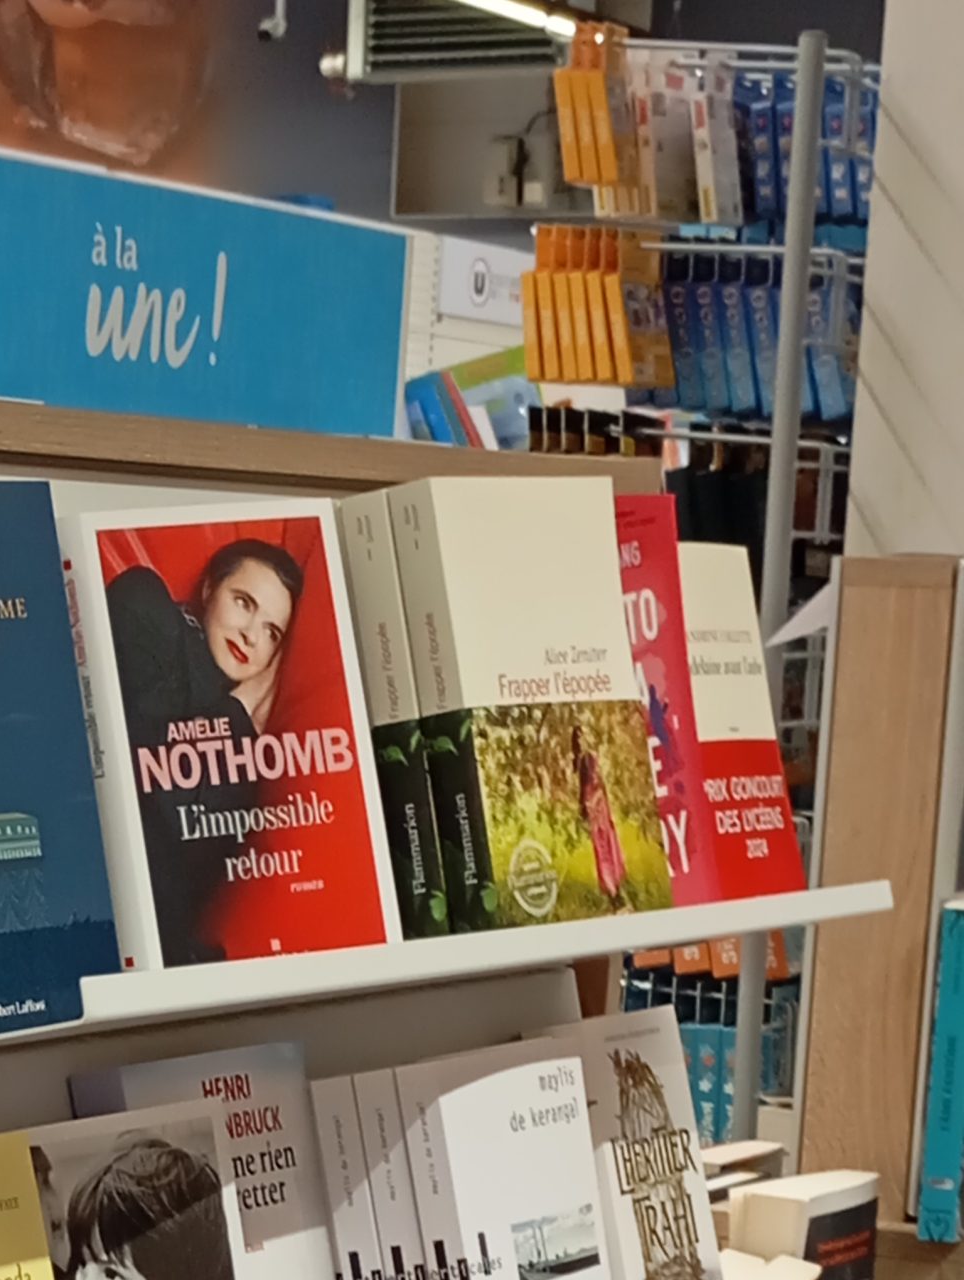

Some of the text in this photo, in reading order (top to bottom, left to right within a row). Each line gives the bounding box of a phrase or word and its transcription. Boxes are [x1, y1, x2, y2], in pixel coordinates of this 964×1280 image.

[92, 223, 138, 272] à la
[497, 670, 612, 702] Frapper l'épopée
[166, 716, 232, 742] AMÉLIE
[137, 727, 355, 793] NOTHOMB
[177, 791, 335, 843] L'impossible
[715, 810, 740, 835] DES
[402, 802, 426, 896] Flammarion
[454, 792, 479, 886] Flammarion
[224, 847, 303, 882] retour
[201, 1073, 252, 1103] HENRI
[509, 1110, 527, 1133] de
[259, 1140, 297, 1174] rien
